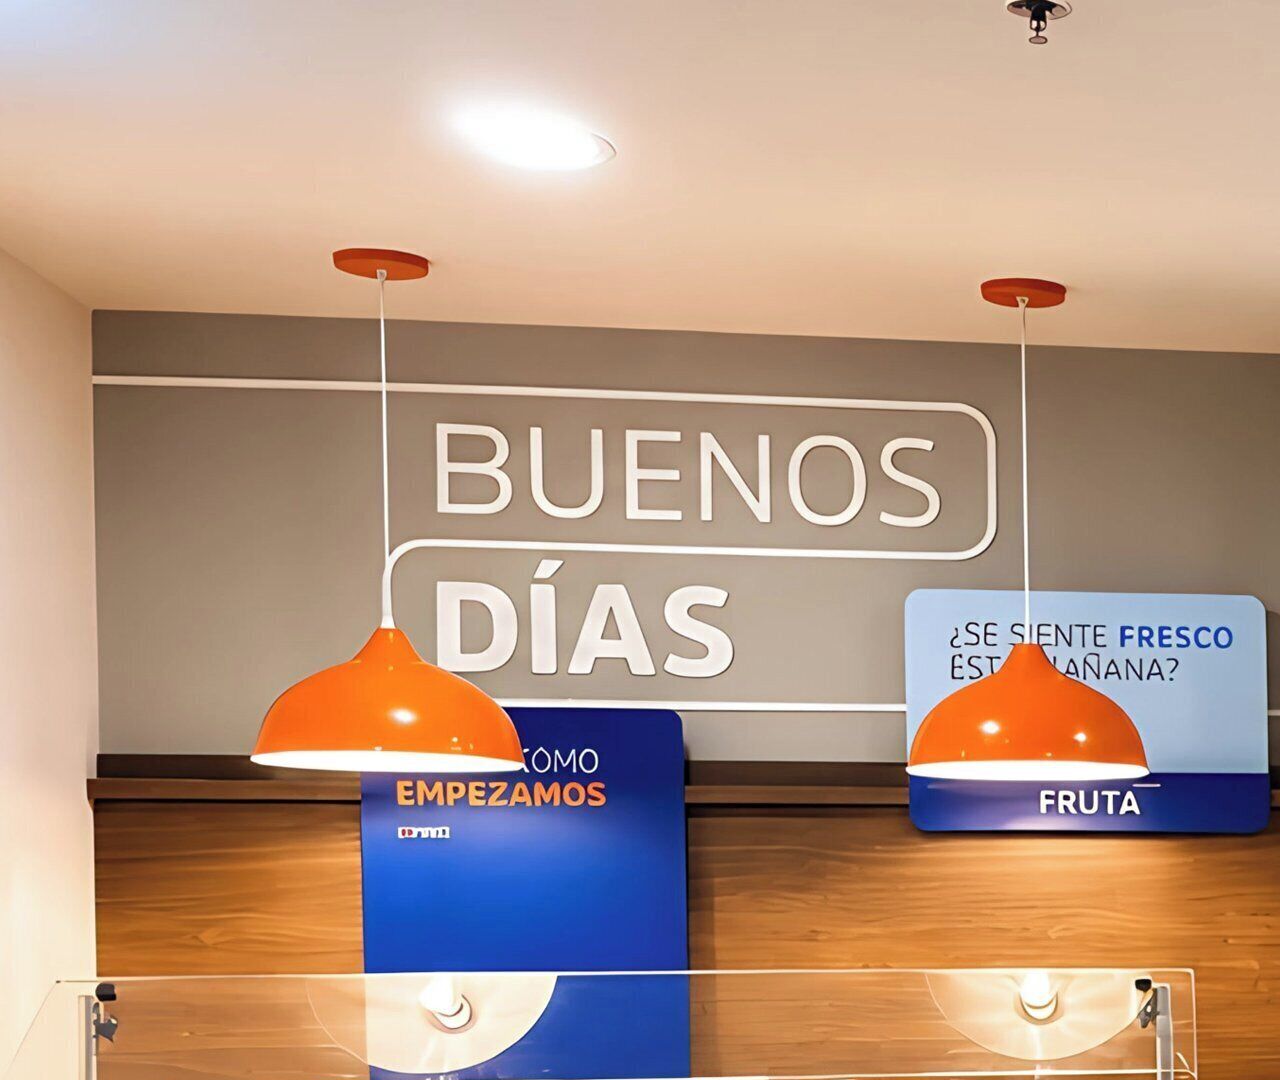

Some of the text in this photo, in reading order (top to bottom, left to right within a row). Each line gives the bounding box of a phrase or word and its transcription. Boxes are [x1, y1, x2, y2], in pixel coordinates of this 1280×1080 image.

[434, 421, 943, 529] BUENOS
[434, 559, 736, 679] DÍAS
[950, 621, 1234, 650] ¿SE SIENTE FRESCO
[951, 652, 1180, 682] EST AÑANA?
[522, 746, 600, 774] OMO
[396, 780, 607, 807] EMPEZAMOS
[1039, 789, 1141, 816] FRUTA
